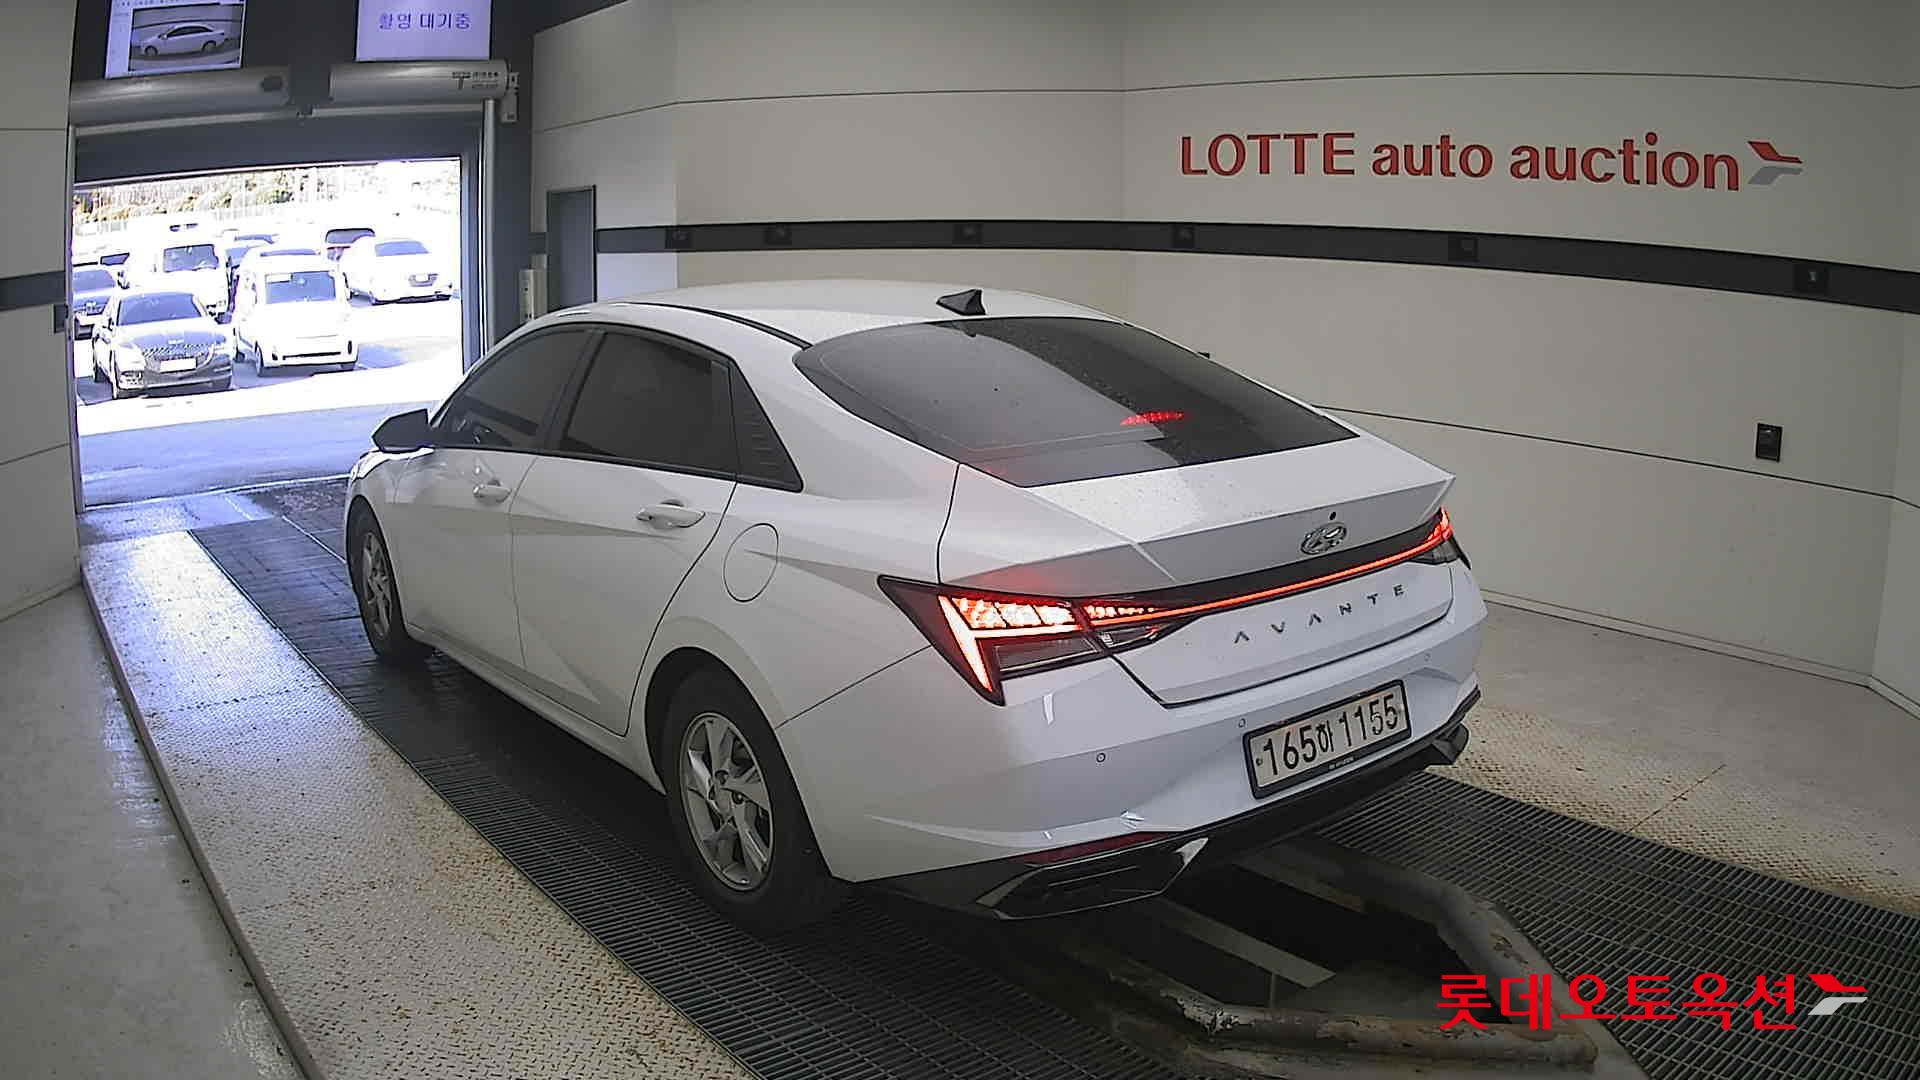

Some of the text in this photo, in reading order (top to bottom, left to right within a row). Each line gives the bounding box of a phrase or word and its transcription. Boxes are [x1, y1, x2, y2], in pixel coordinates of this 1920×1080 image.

[419, 12, 472, 31] 대기중
[1181, 132, 1740, 191] LOTTE auto auction
[1233, 583, 1406, 644] AVANTE
[1338, 693, 1399, 748] 1155
